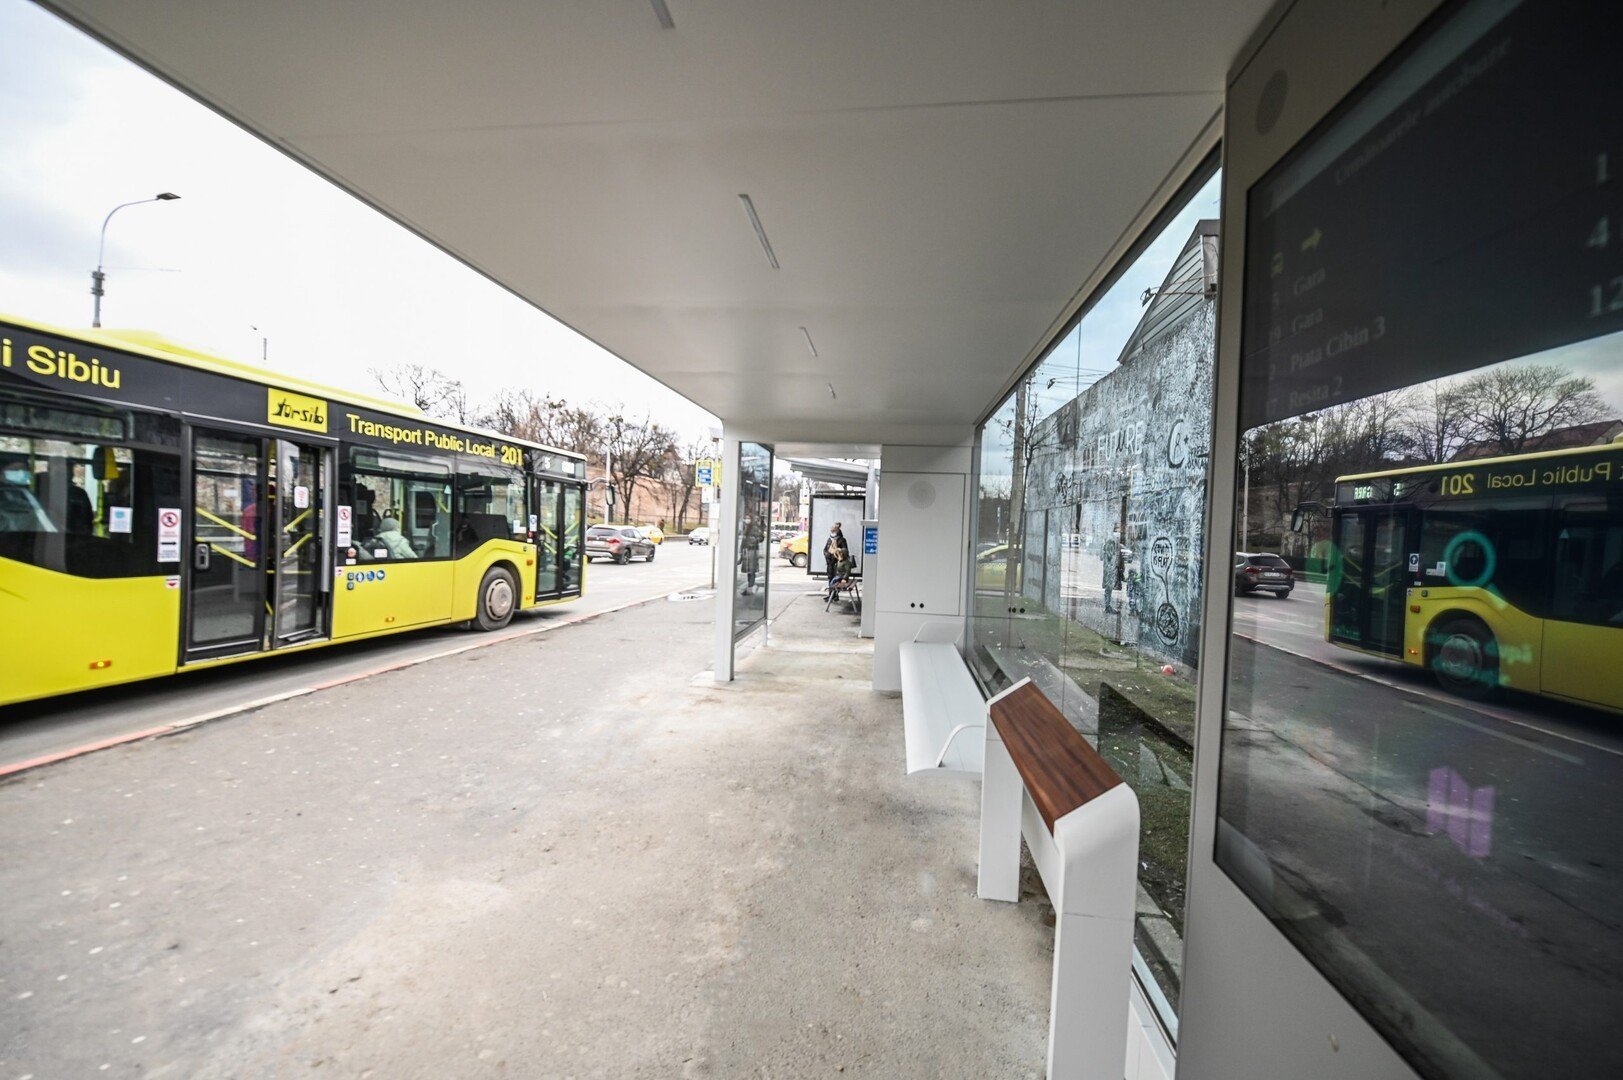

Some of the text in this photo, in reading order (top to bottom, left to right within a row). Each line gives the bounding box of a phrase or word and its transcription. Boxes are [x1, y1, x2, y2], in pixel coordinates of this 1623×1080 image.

[1586, 216, 1610, 248] 4
[1293, 267, 1326, 295] Gara
[1292, 307, 1324, 335] Gara
[1326, 325, 1369, 358] Cibin
[1373, 316, 1386, 340] 3
[26, 345, 121, 389] Sibiu
[1332, 375, 1344, 397] 2
[345, 413, 524, 467] Transport Public Local 201
